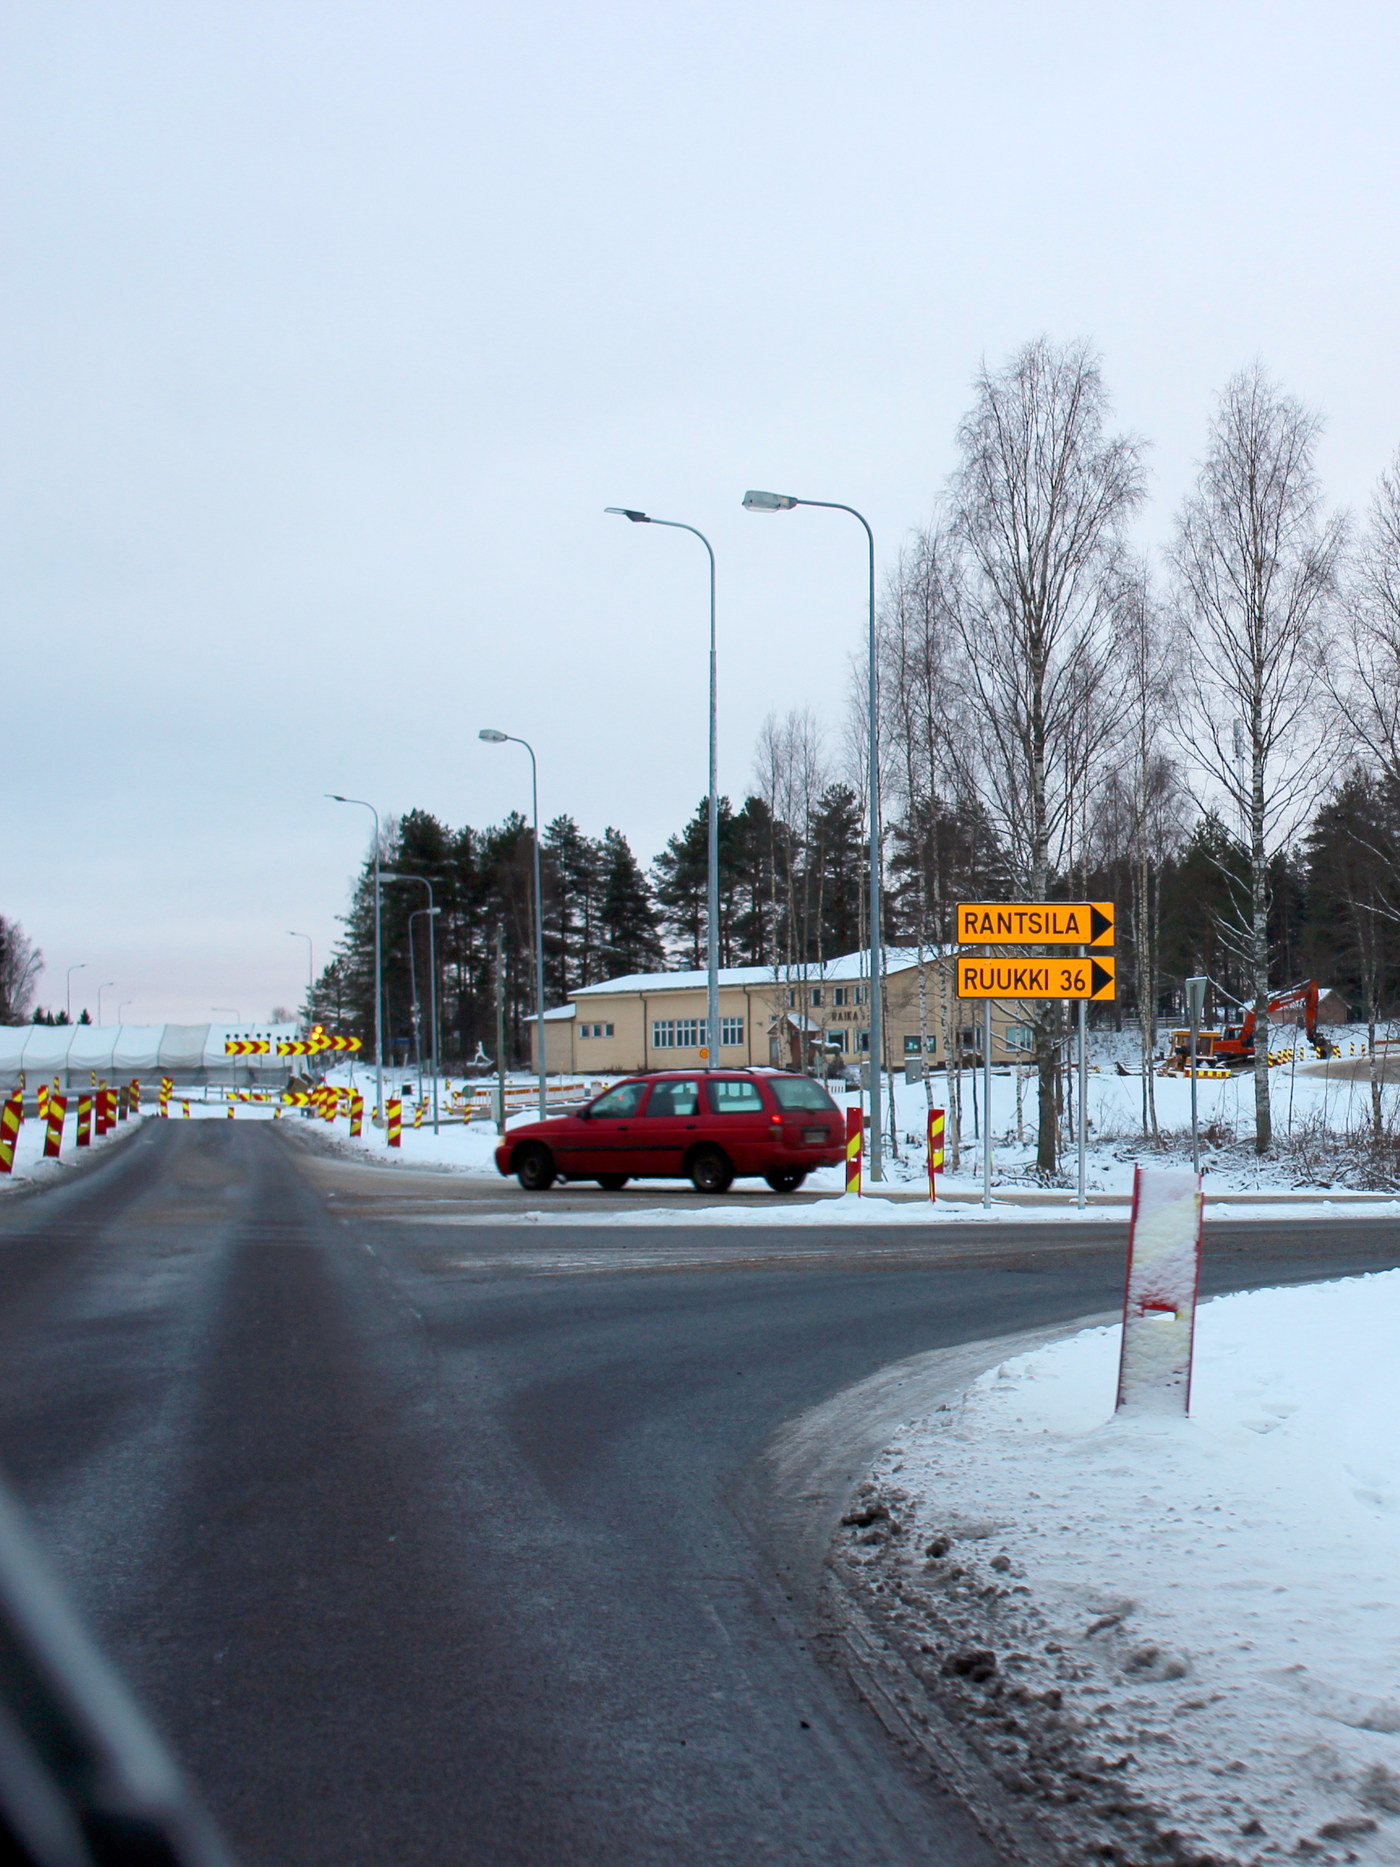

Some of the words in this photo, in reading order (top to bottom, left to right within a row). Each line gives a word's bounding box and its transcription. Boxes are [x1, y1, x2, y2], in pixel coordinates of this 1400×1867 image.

[964, 912, 1080, 934] RANTSILA
[964, 968, 1049, 990] RUUKKI
[1060, 969, 1086, 991] 36
